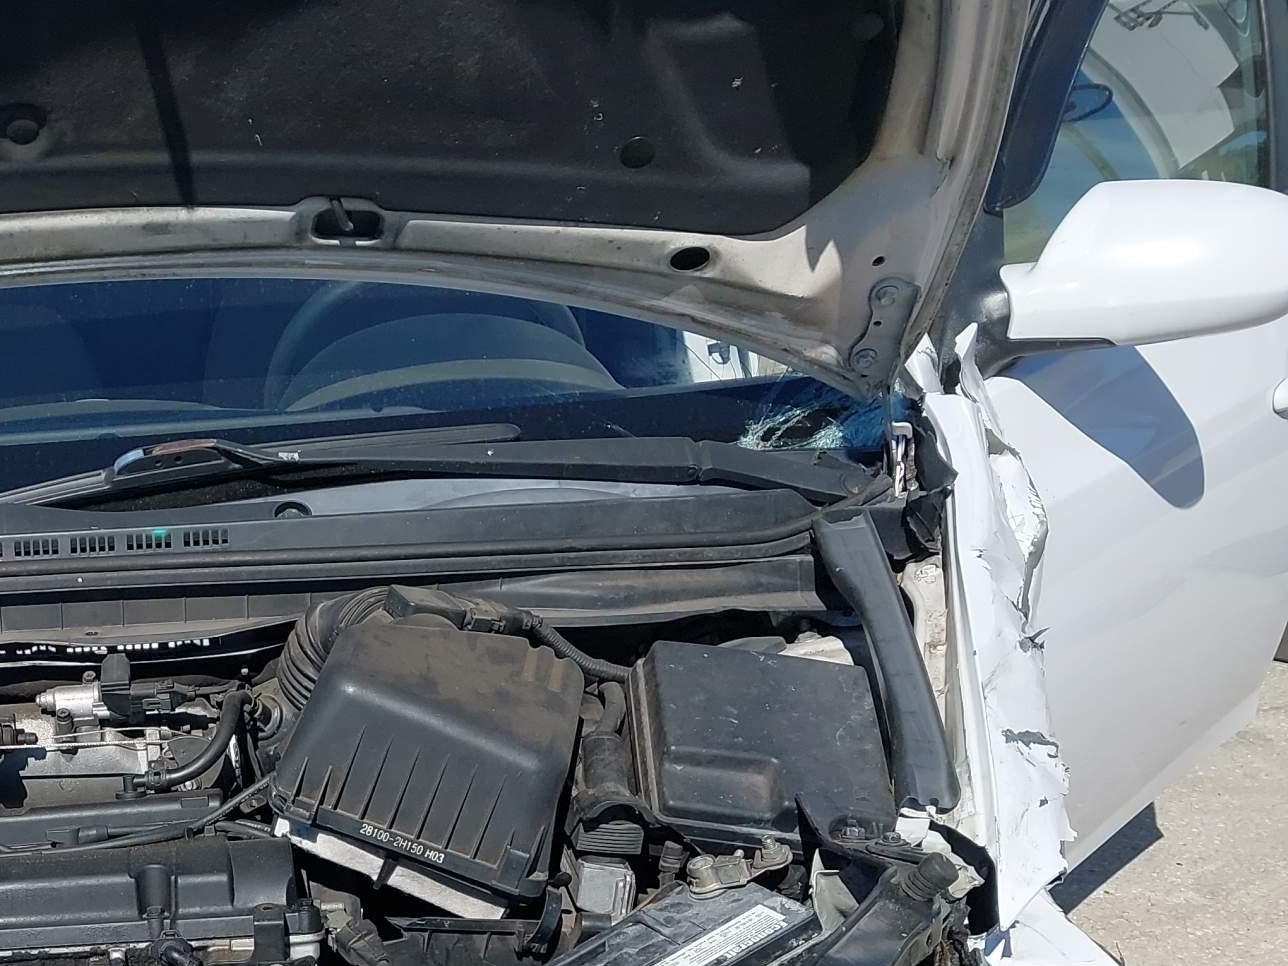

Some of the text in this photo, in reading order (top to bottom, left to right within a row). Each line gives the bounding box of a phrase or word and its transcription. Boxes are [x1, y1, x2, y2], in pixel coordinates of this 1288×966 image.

[359, 823, 445, 864] 28100-2H150 H03
[724, 920, 788, 958] Econocraft
